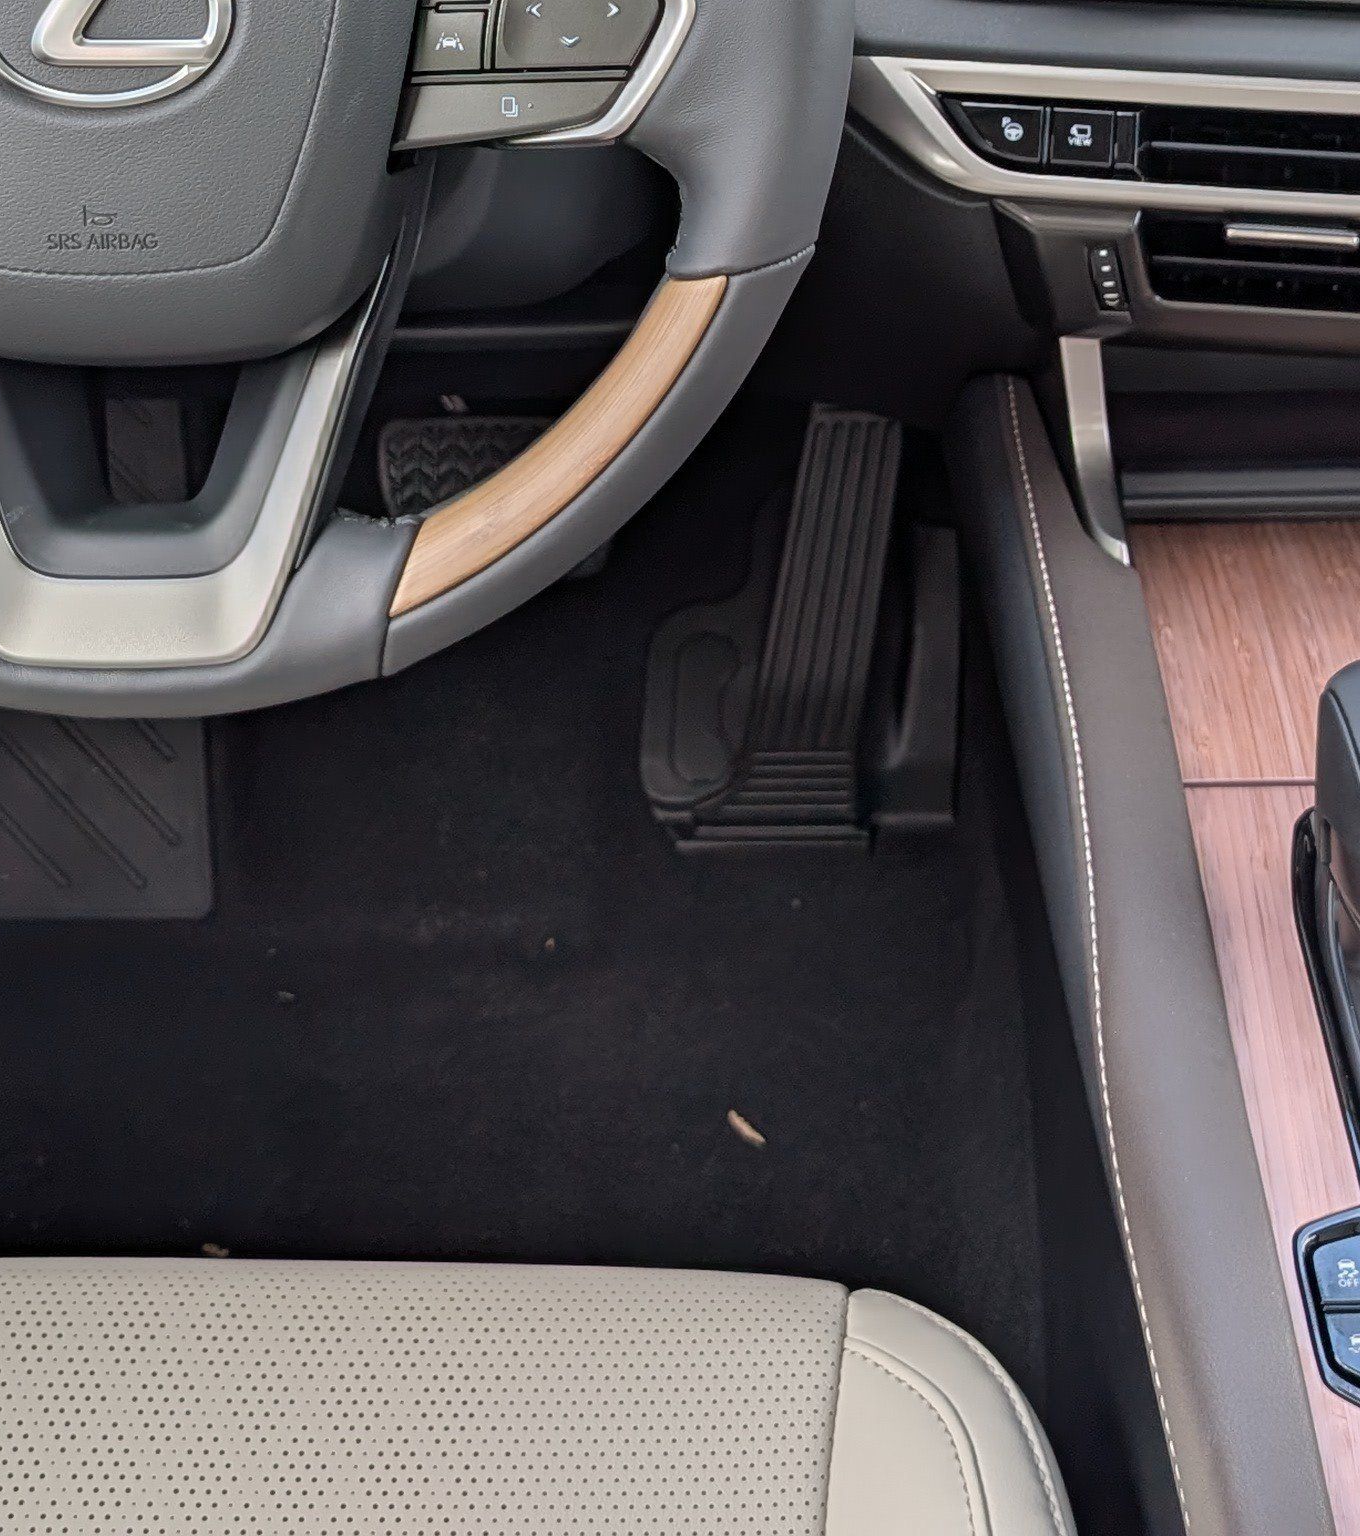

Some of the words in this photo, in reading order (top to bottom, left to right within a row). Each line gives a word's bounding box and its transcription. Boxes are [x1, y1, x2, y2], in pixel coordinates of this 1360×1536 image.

[46, 233, 82, 250] SRS
[86, 233, 159, 250] AIRBAG
[1338, 1278, 1359, 1288] OFF
